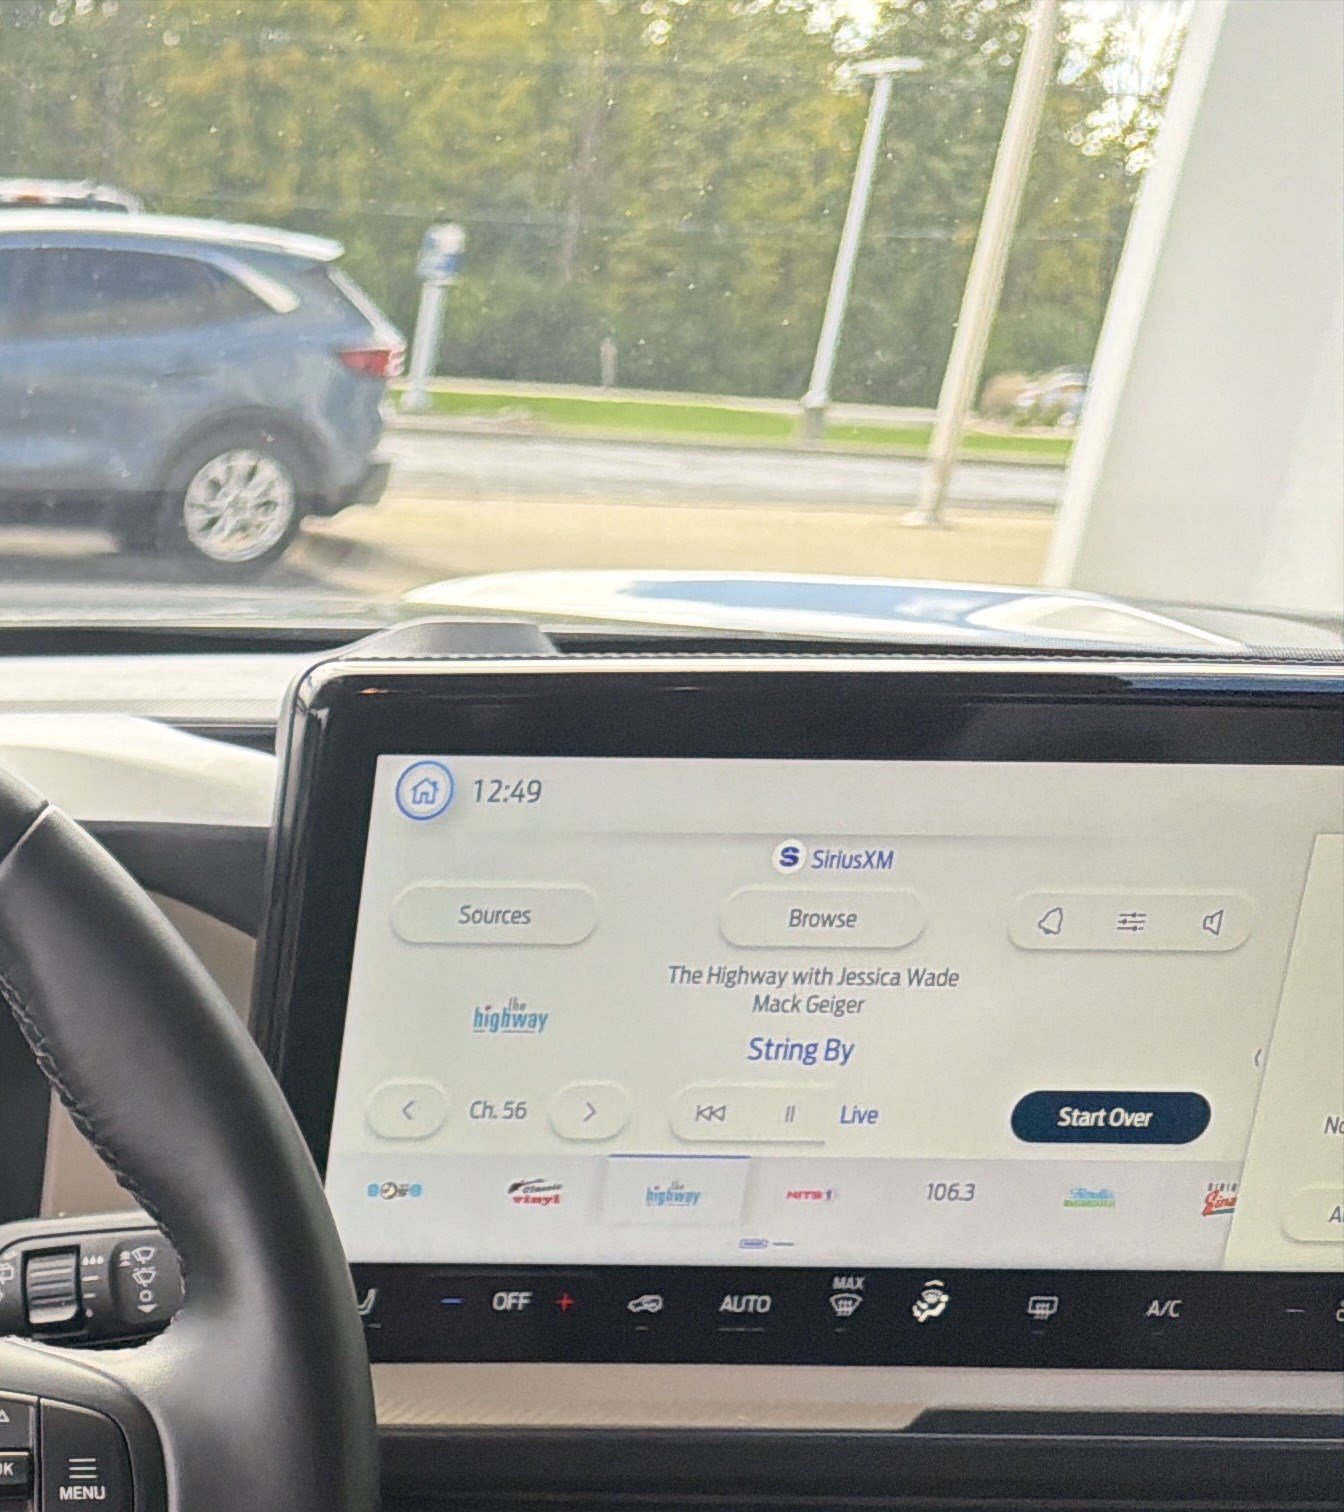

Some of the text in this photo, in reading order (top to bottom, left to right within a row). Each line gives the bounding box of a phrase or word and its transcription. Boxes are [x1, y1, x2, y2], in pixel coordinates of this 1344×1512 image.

[472, 778, 543, 804] 12:49
[811, 849, 895, 870] SiriusXM
[458, 904, 532, 925] Sources
[788, 908, 858, 929] Browse
[668, 965, 961, 989] The Highway with Jessica Wade
[752, 994, 866, 1017] Mack Geiger
[472, 1004, 549, 1034] highway
[746, 1036, 856, 1067] String By
[469, 1100, 529, 1120] Ch. 56
[839, 1104, 880, 1125] Live
[1056, 1106, 1154, 1128] Start Over
[926, 1181, 976, 1202] 106.3
[832, 1276, 865, 1291] MAX
[492, 1291, 533, 1311] OFF
[719, 1295, 772, 1313] AUTO
[1145, 1299, 1182, 1318] A/C
[59, 1485, 106, 1501] MENU
